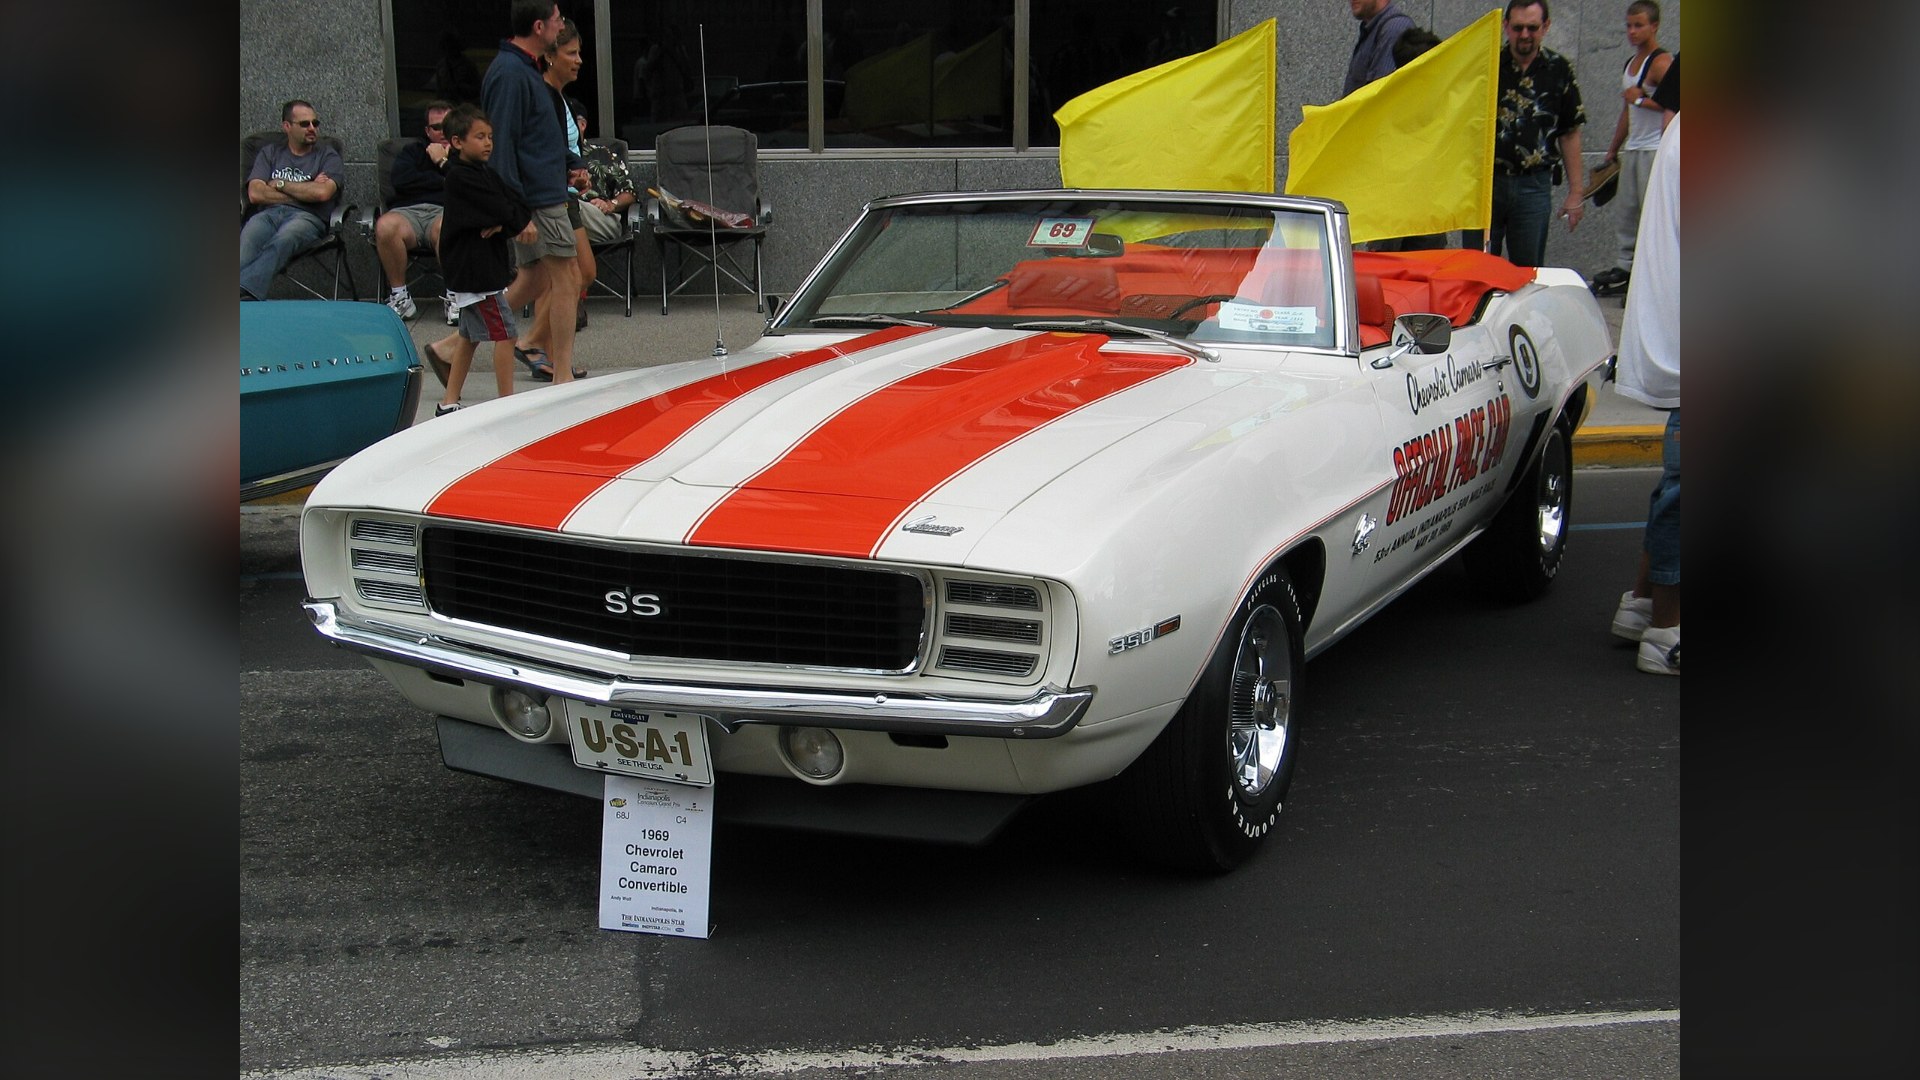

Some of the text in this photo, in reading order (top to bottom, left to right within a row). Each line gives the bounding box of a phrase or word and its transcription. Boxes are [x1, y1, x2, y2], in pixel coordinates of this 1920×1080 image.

[1049, 222, 1077, 238] 69
[241, 352, 394, 376] BONNEVILLE
[1406, 353, 1483, 415] Chevrolet Camaro
[1386, 393, 1511, 526] OFFICIAL PACE CAR
[1390, 526, 1418, 553] ANNUAL
[1417, 502, 1458, 535] INDIANAPOLIS
[605, 591, 661, 616] SS
[1108, 628, 1153, 656] 350
[613, 711, 645, 721] CHEVROLET
[617, 758, 664, 771] SEE THE USA
[637, 792, 671, 802] Indianapolis
[616, 811, 687, 824] 68J C4
[1227, 785, 1282, 837] GOODYEAR
[641, 829, 669, 841] 1969
[625, 844, 683, 860] Chevrolet
[630, 861, 677, 876] Camaro
[618, 877, 688, 894] Convertible
[633, 915, 670, 925] INDIANAPOLIS
[671, 918, 685, 926] STAR
